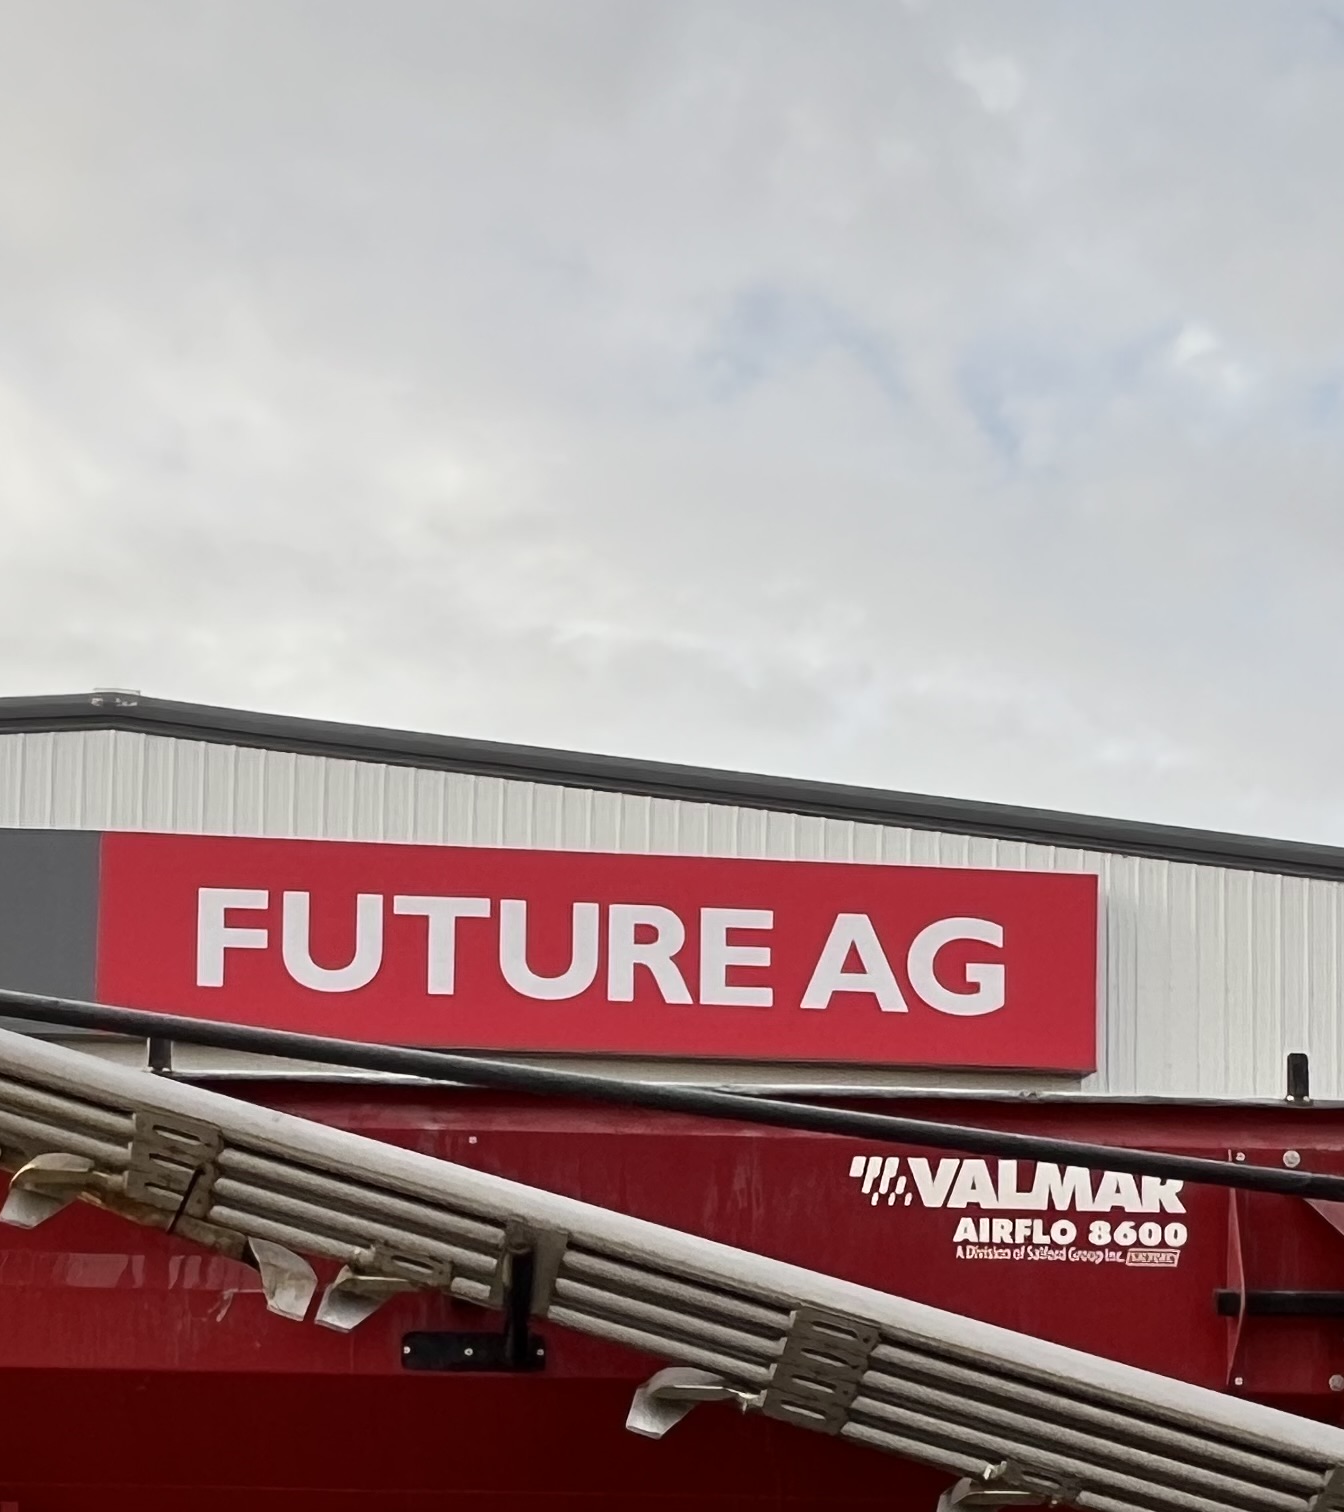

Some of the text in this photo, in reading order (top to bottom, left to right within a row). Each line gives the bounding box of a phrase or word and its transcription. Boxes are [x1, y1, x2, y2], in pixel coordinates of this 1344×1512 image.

[196, 887, 1006, 1017] FUTURE AG
[906, 1157, 1187, 1214] VALMAR
[953, 1217, 1188, 1248] AIRFLO 8600
[956, 1245, 965, 1259] A
[966, 1245, 1011, 1260] Division
[1013, 1245, 1025, 1260] of
